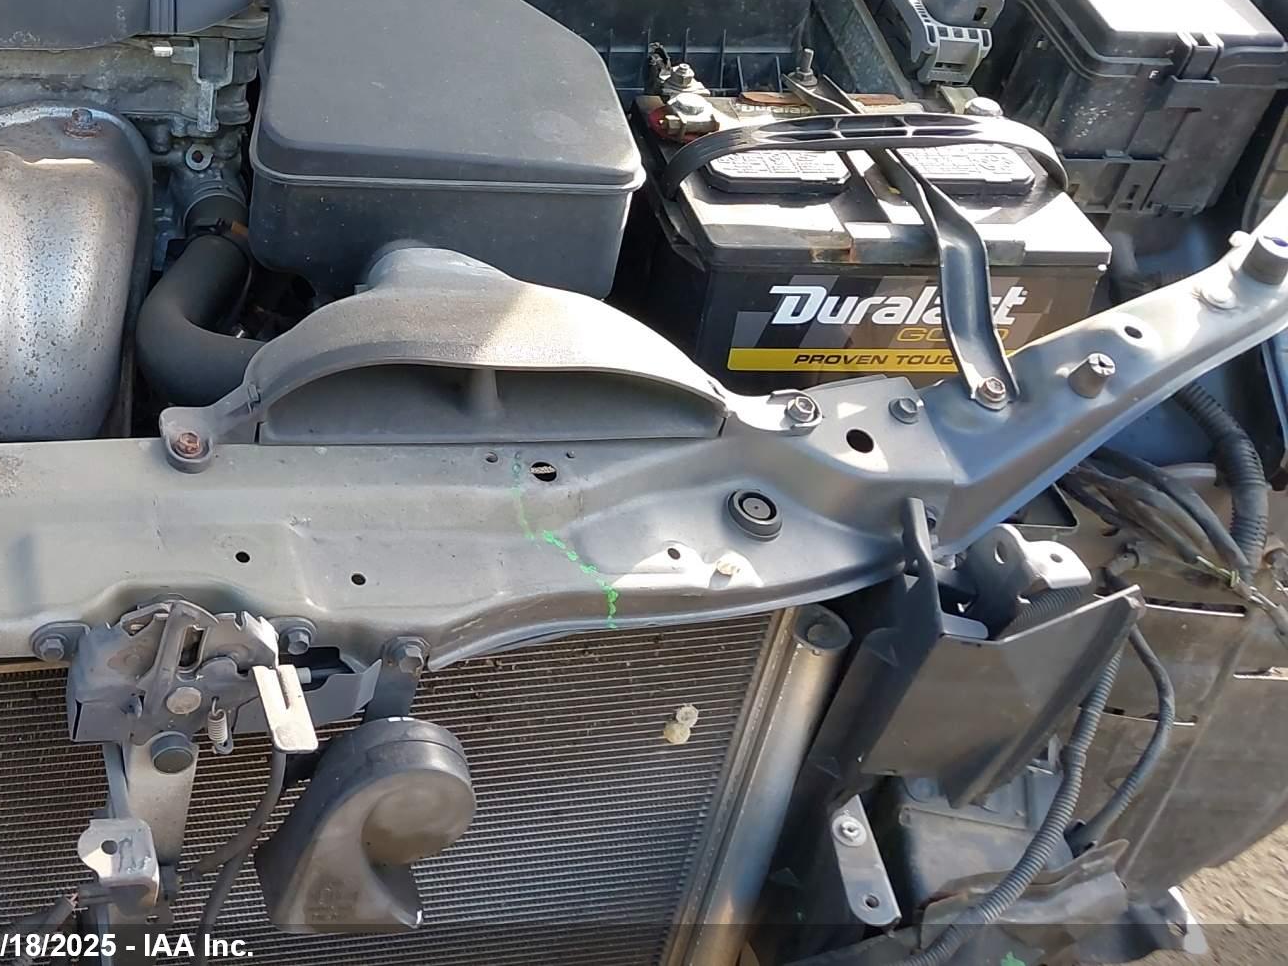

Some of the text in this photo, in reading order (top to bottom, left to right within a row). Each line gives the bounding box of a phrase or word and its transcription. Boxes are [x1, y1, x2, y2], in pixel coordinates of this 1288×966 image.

[769, 285, 1027, 325] Duralat
[896, 328, 1008, 342] GO
[794, 354, 954, 365] PROVEN TOUG
